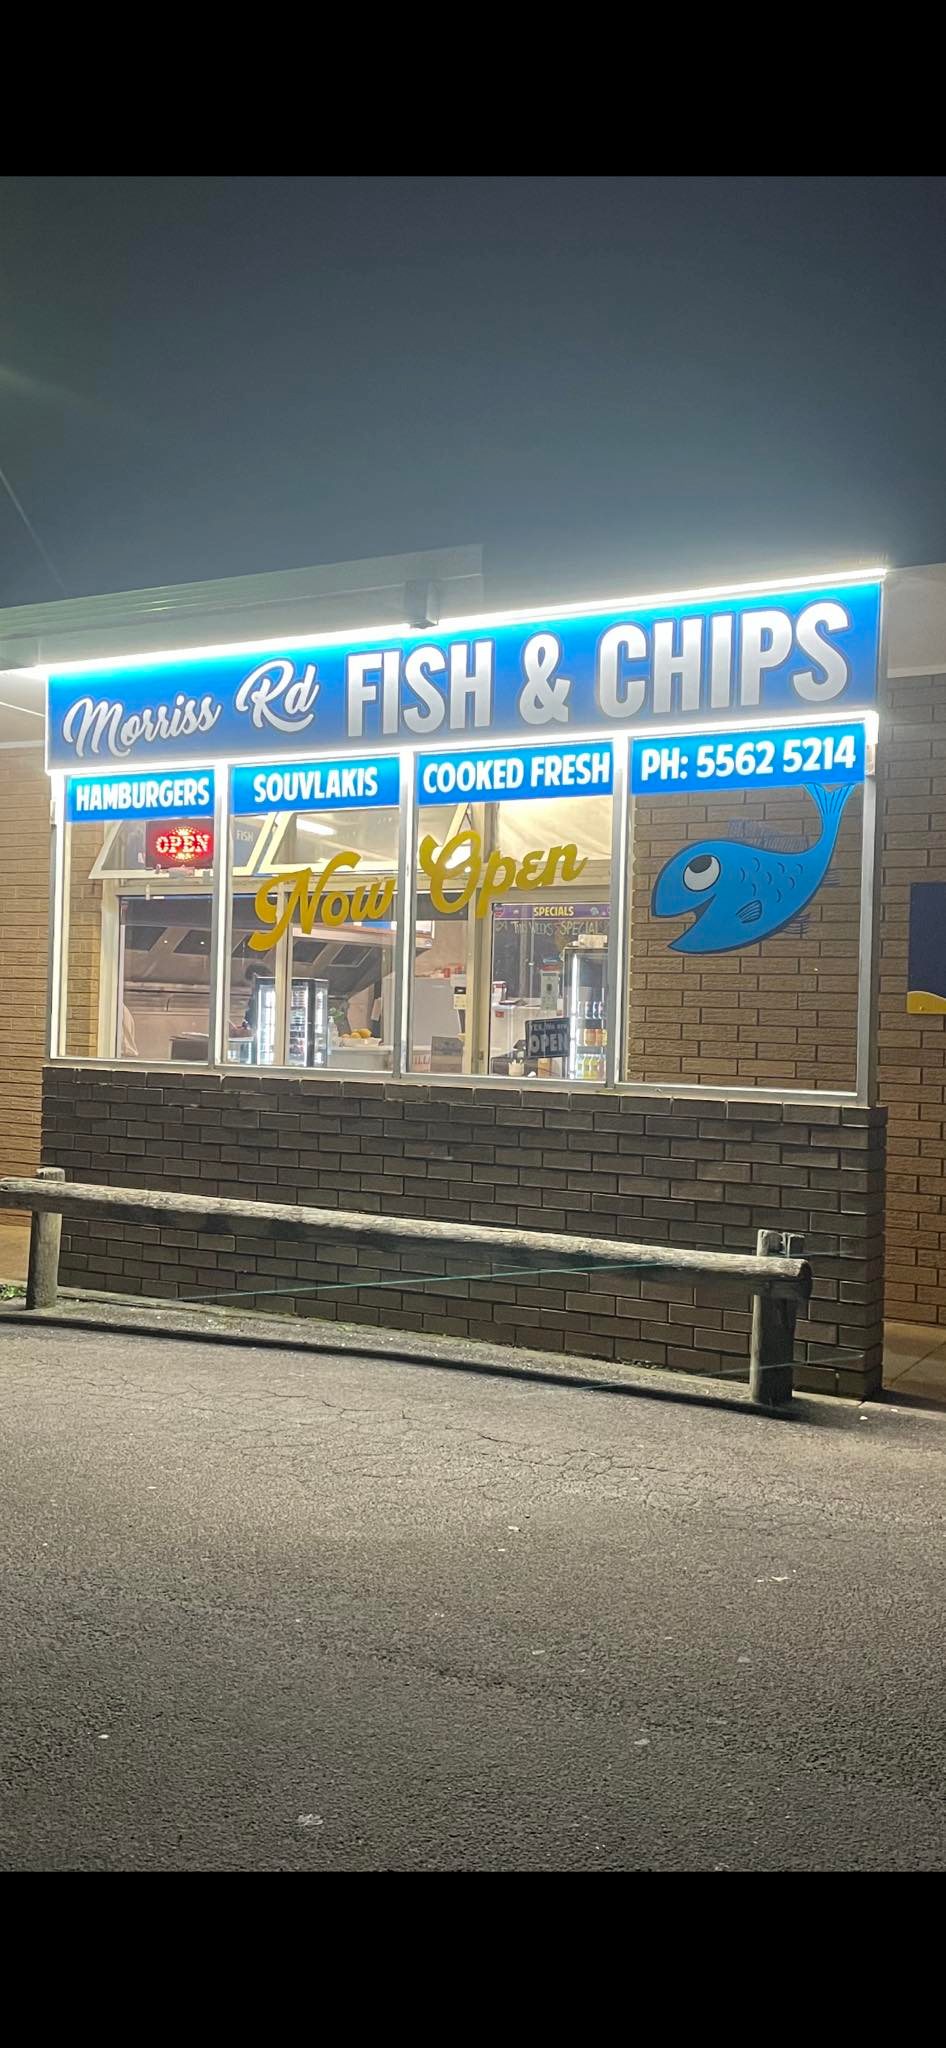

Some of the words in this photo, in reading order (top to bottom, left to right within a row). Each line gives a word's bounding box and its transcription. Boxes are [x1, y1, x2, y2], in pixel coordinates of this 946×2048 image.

[63, 694, 221, 757] Morriss
[236, 659, 320, 732] Rd
[347, 640, 492, 737] FISH
[519, 634, 571, 724] &
[600, 602, 850, 718] CHIPS
[422, 758, 523, 793] COOKED
[531, 752, 610, 785] FRESH
[641, 747, 689, 781] PH:
[697, 741, 774, 778] 5562
[783, 736, 856, 773] 5214
[76, 777, 210, 811] HAMBURGERS
[253, 767, 378, 802] SOUVLAKIS
[156, 834, 210, 853] OPEN
[248, 851, 396, 951] Now
[419, 830, 588, 919] Open
[533, 906, 574, 917] SPECIALS
[530, 1033, 569, 1052] OPEN
